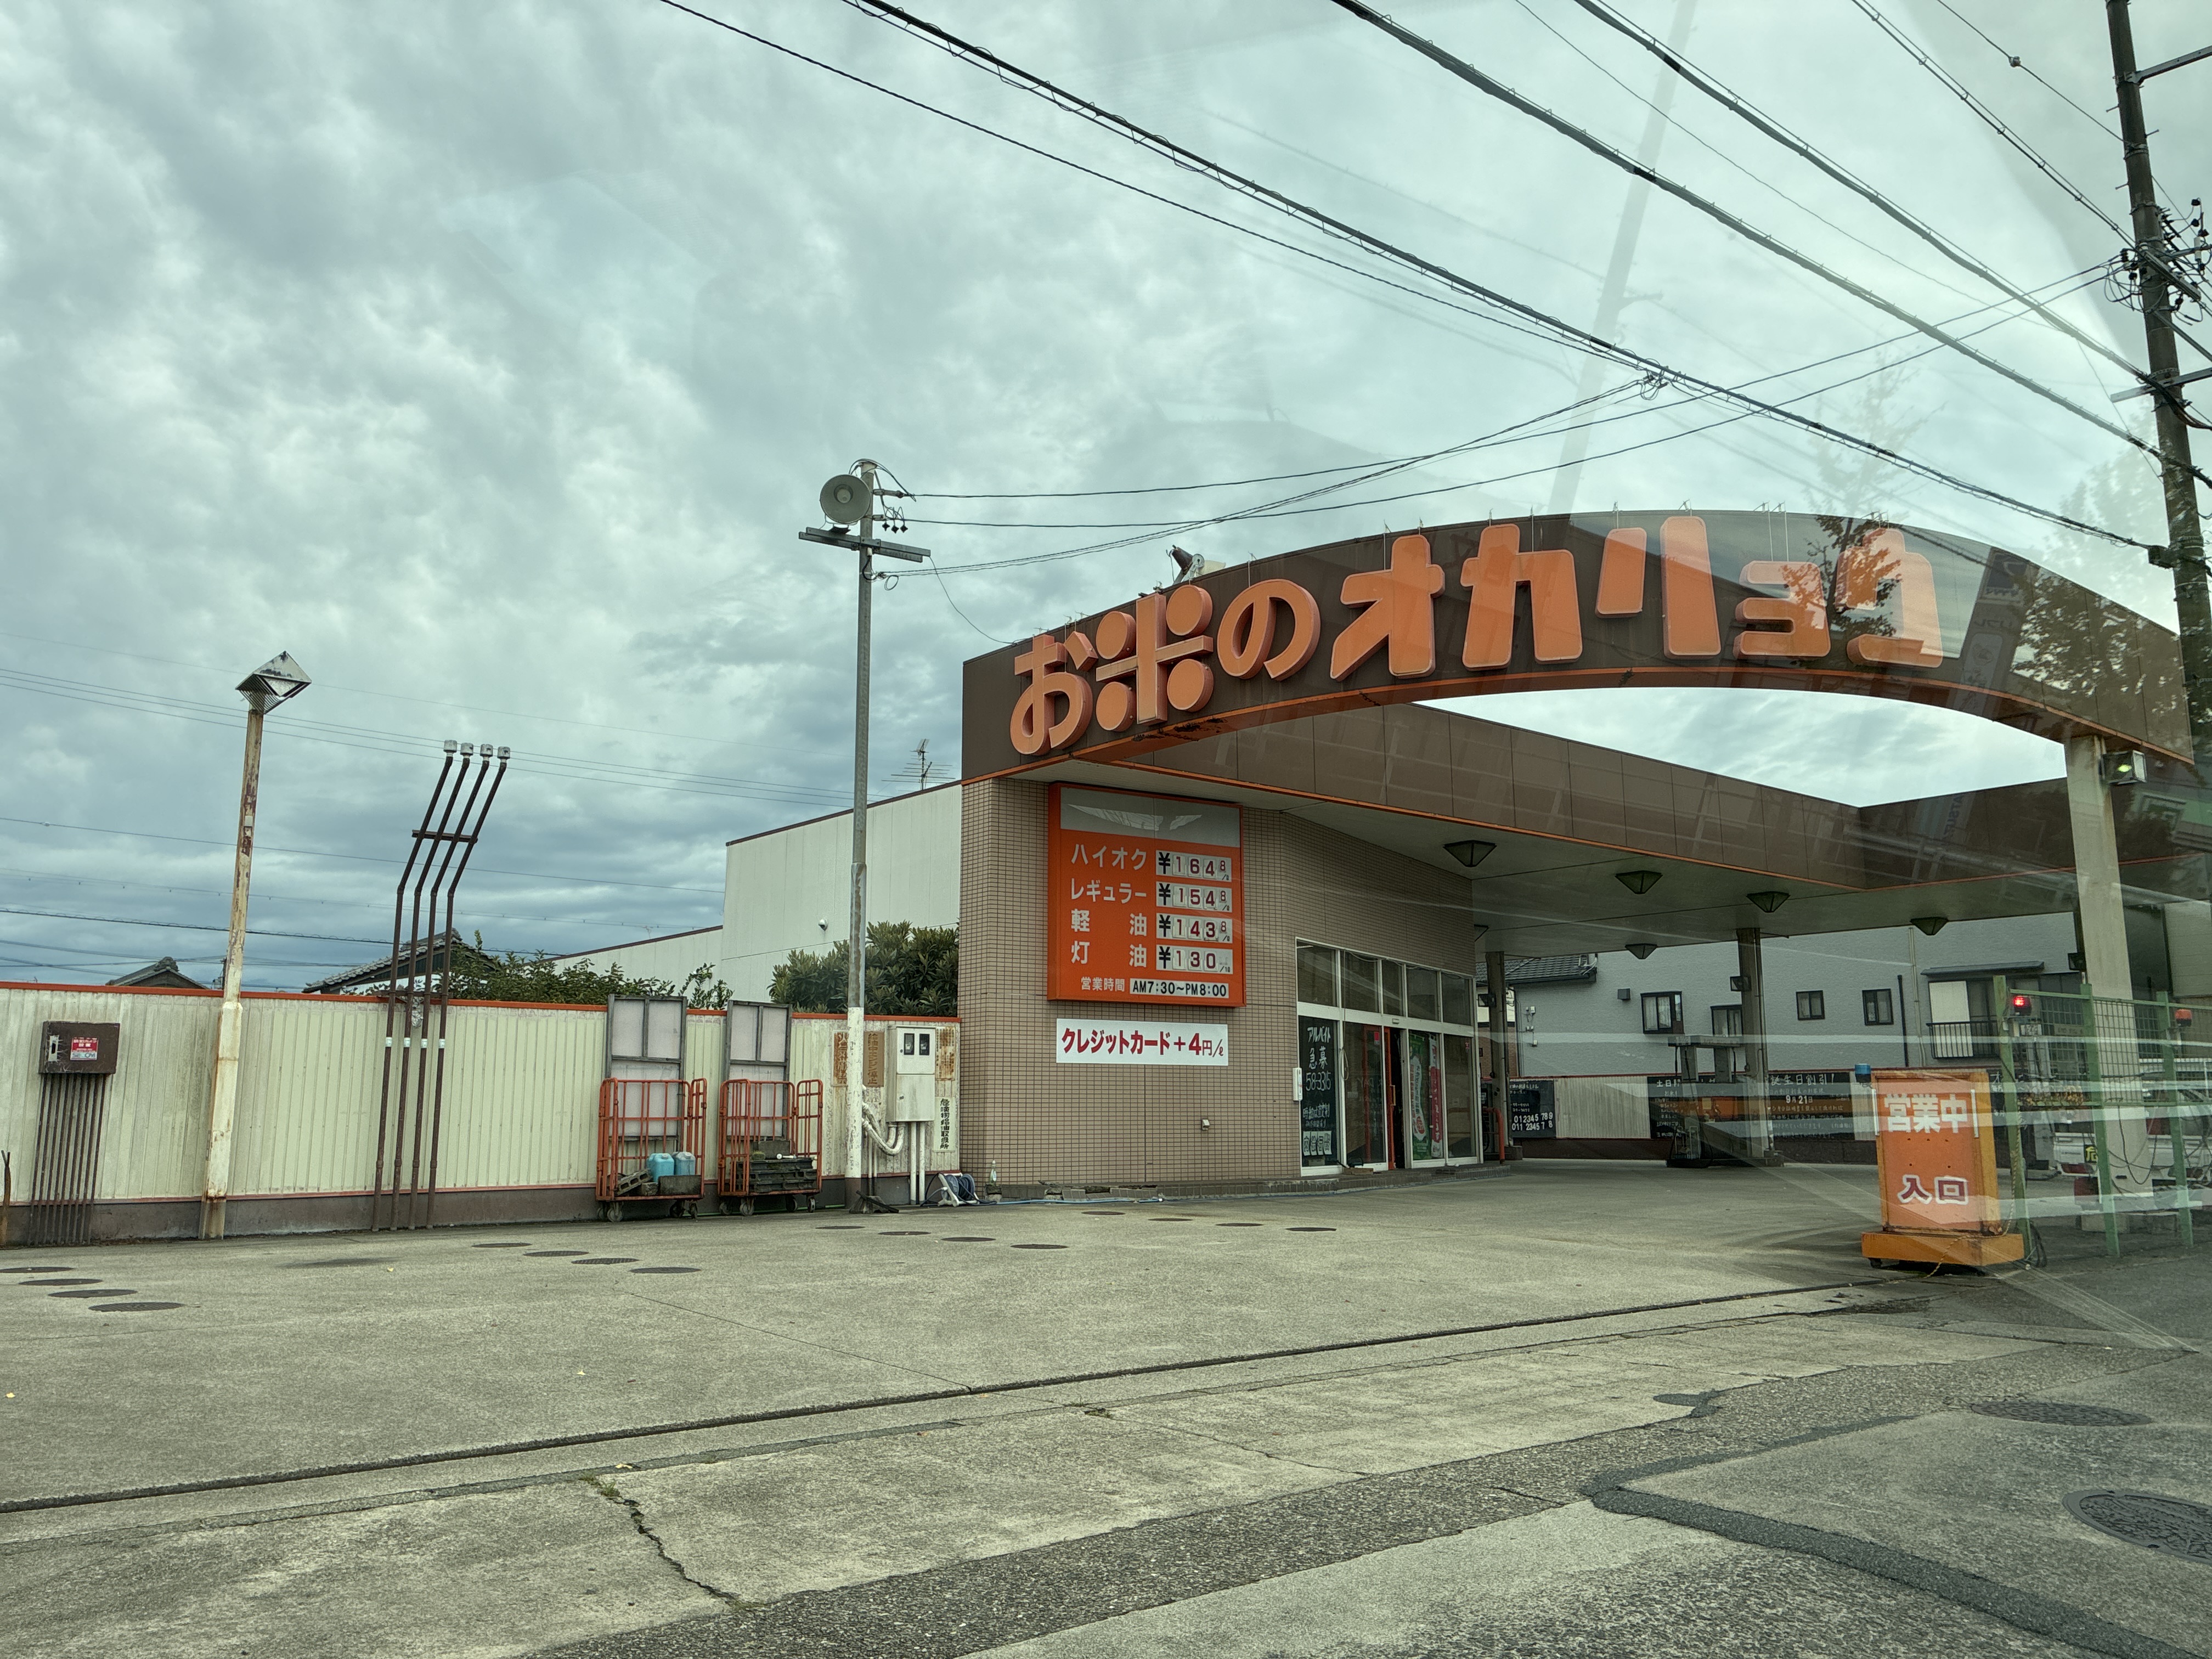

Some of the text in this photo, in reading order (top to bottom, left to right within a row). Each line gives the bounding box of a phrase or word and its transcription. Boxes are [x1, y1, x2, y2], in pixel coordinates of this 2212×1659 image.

[1009, 515, 1943, 755] お米のオカリョウ
[1071, 844, 1147, 871] ハイオク
[1071, 878, 1147, 904] レギュラー
[1081, 976, 1125, 992] 営業時間
[1307, 1026, 1331, 1043] アルバイト
[1309, 1046, 1328, 1070] 急募
[1884, 1093, 1968, 1133] 営業中
[1897, 1175, 1968, 1205] 入口
